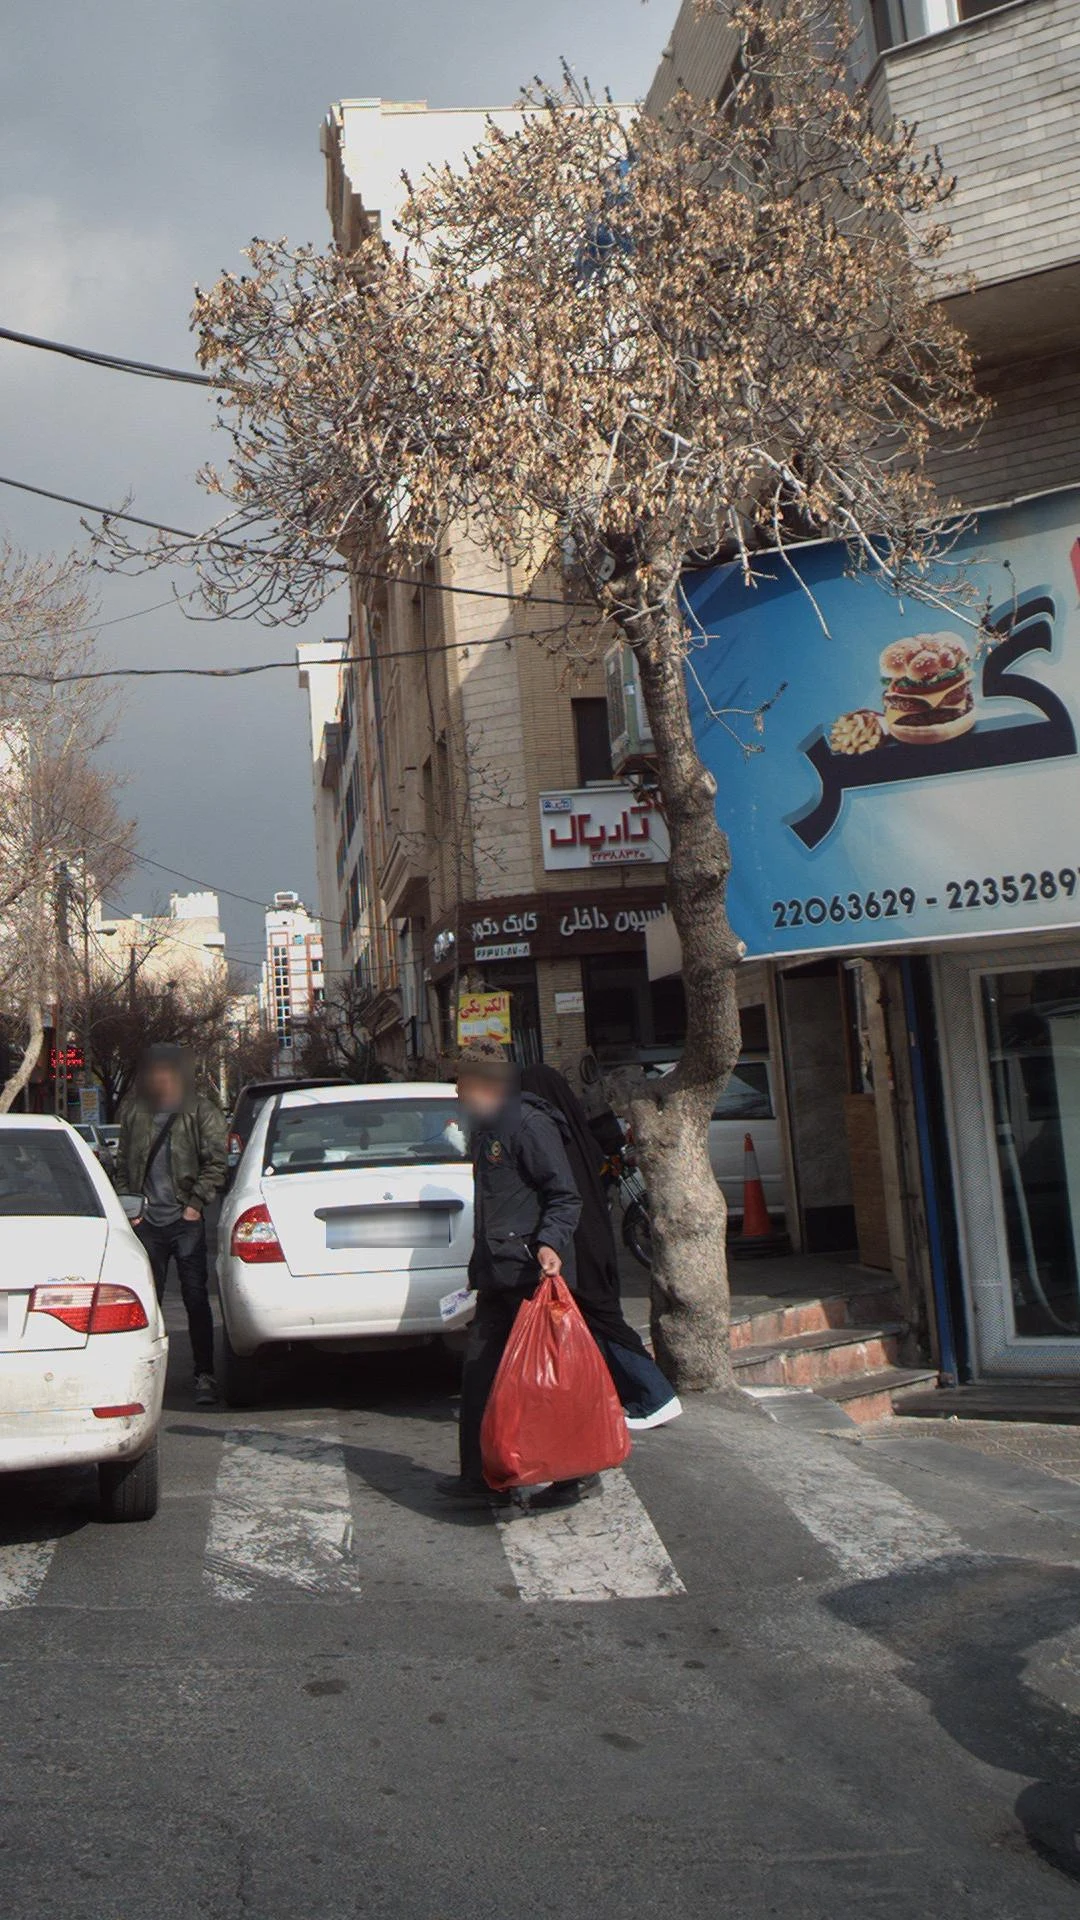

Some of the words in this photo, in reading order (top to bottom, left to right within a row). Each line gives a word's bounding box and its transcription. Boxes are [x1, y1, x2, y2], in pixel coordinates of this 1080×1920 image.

[772, 886, 916, 928] 22063629
[946, 867, 1080, 910] 2235289
[560, 906, 609, 936] داخلی
